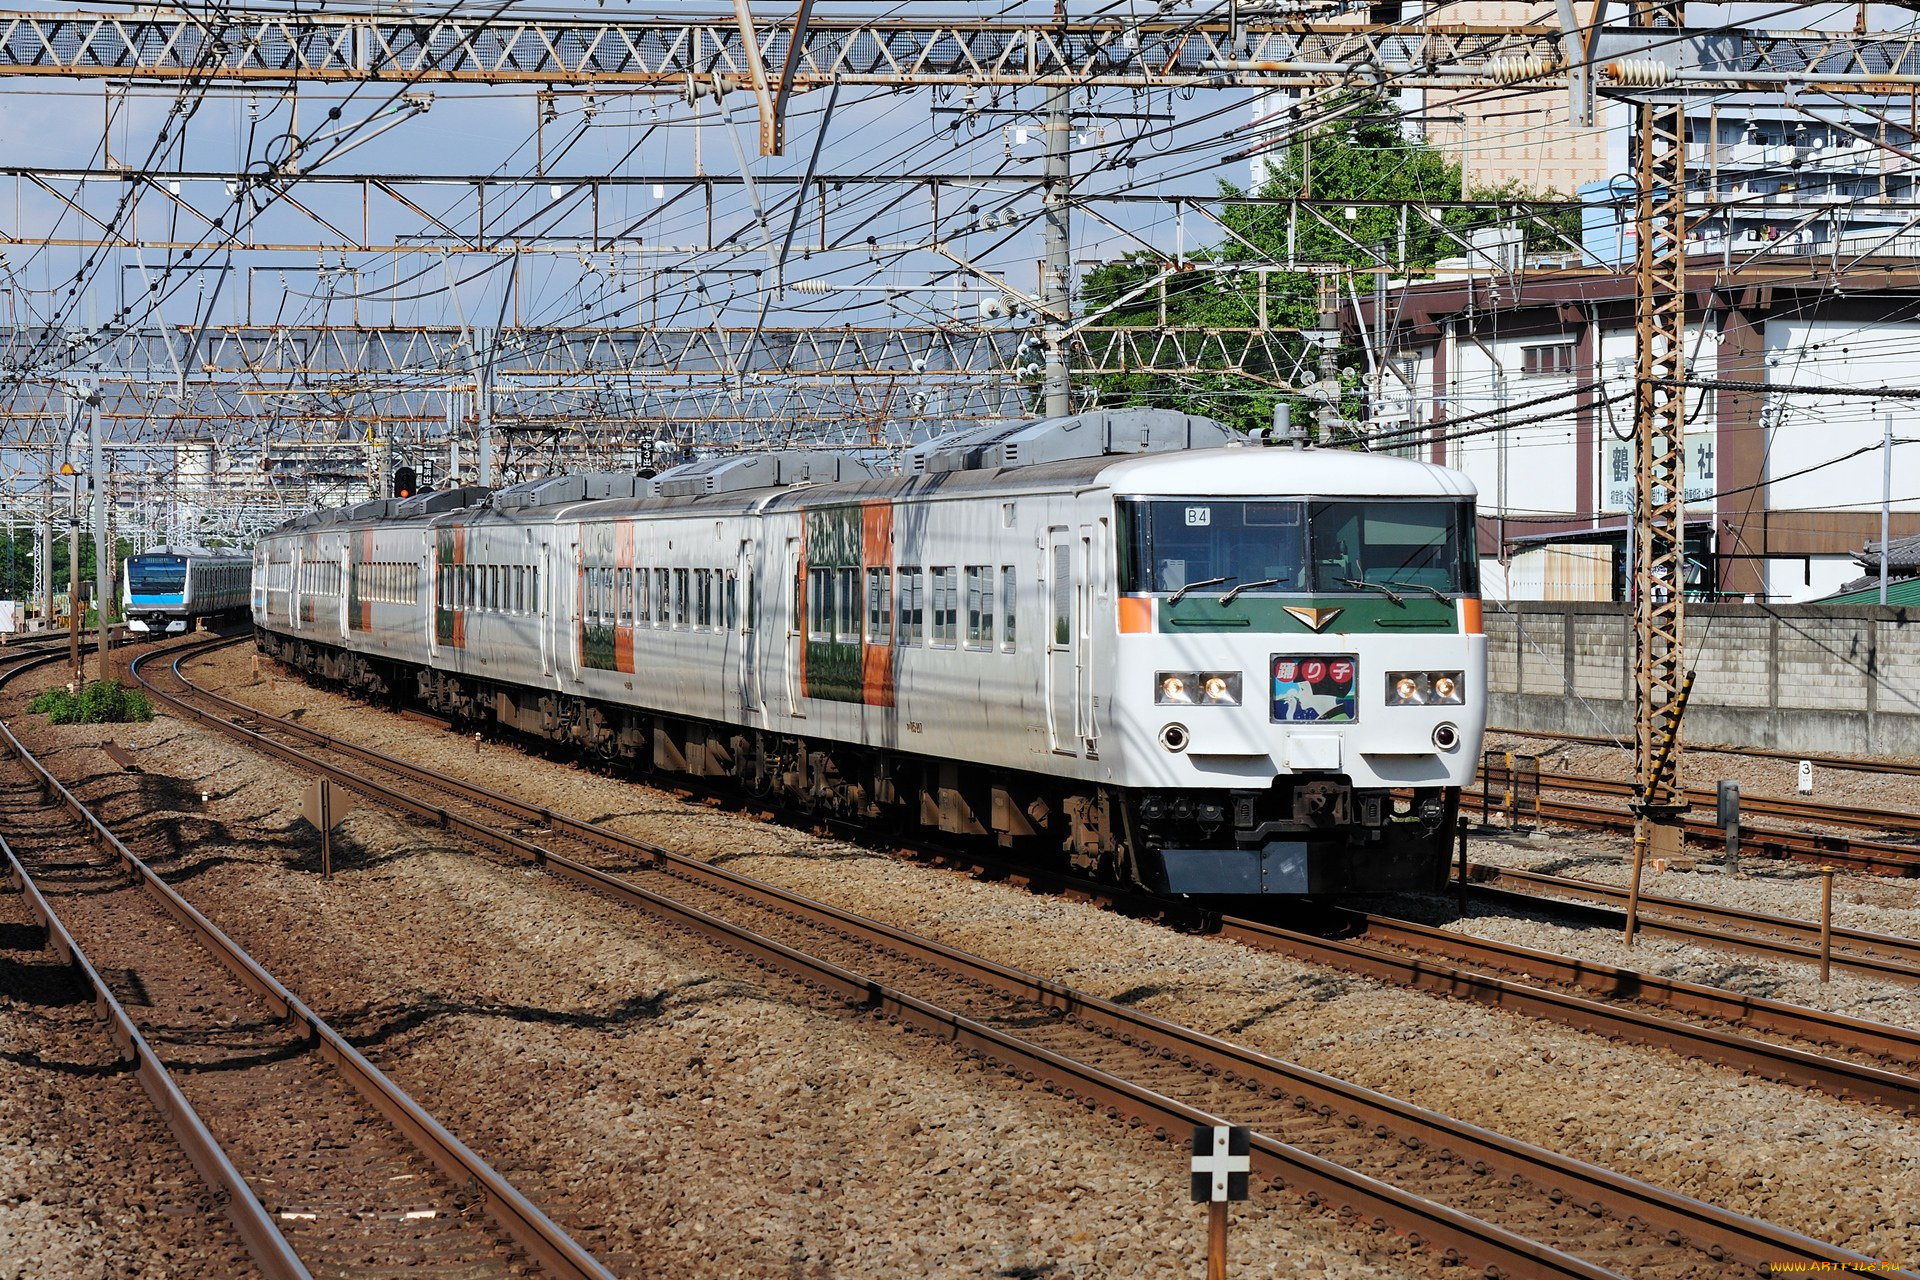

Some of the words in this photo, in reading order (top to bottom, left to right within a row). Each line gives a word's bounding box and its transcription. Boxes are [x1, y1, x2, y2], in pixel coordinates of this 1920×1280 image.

[1188, 510, 1207, 523] B4
[1277, 662, 1350, 680] 踊り子
[1802, 764, 1811, 775] 3
